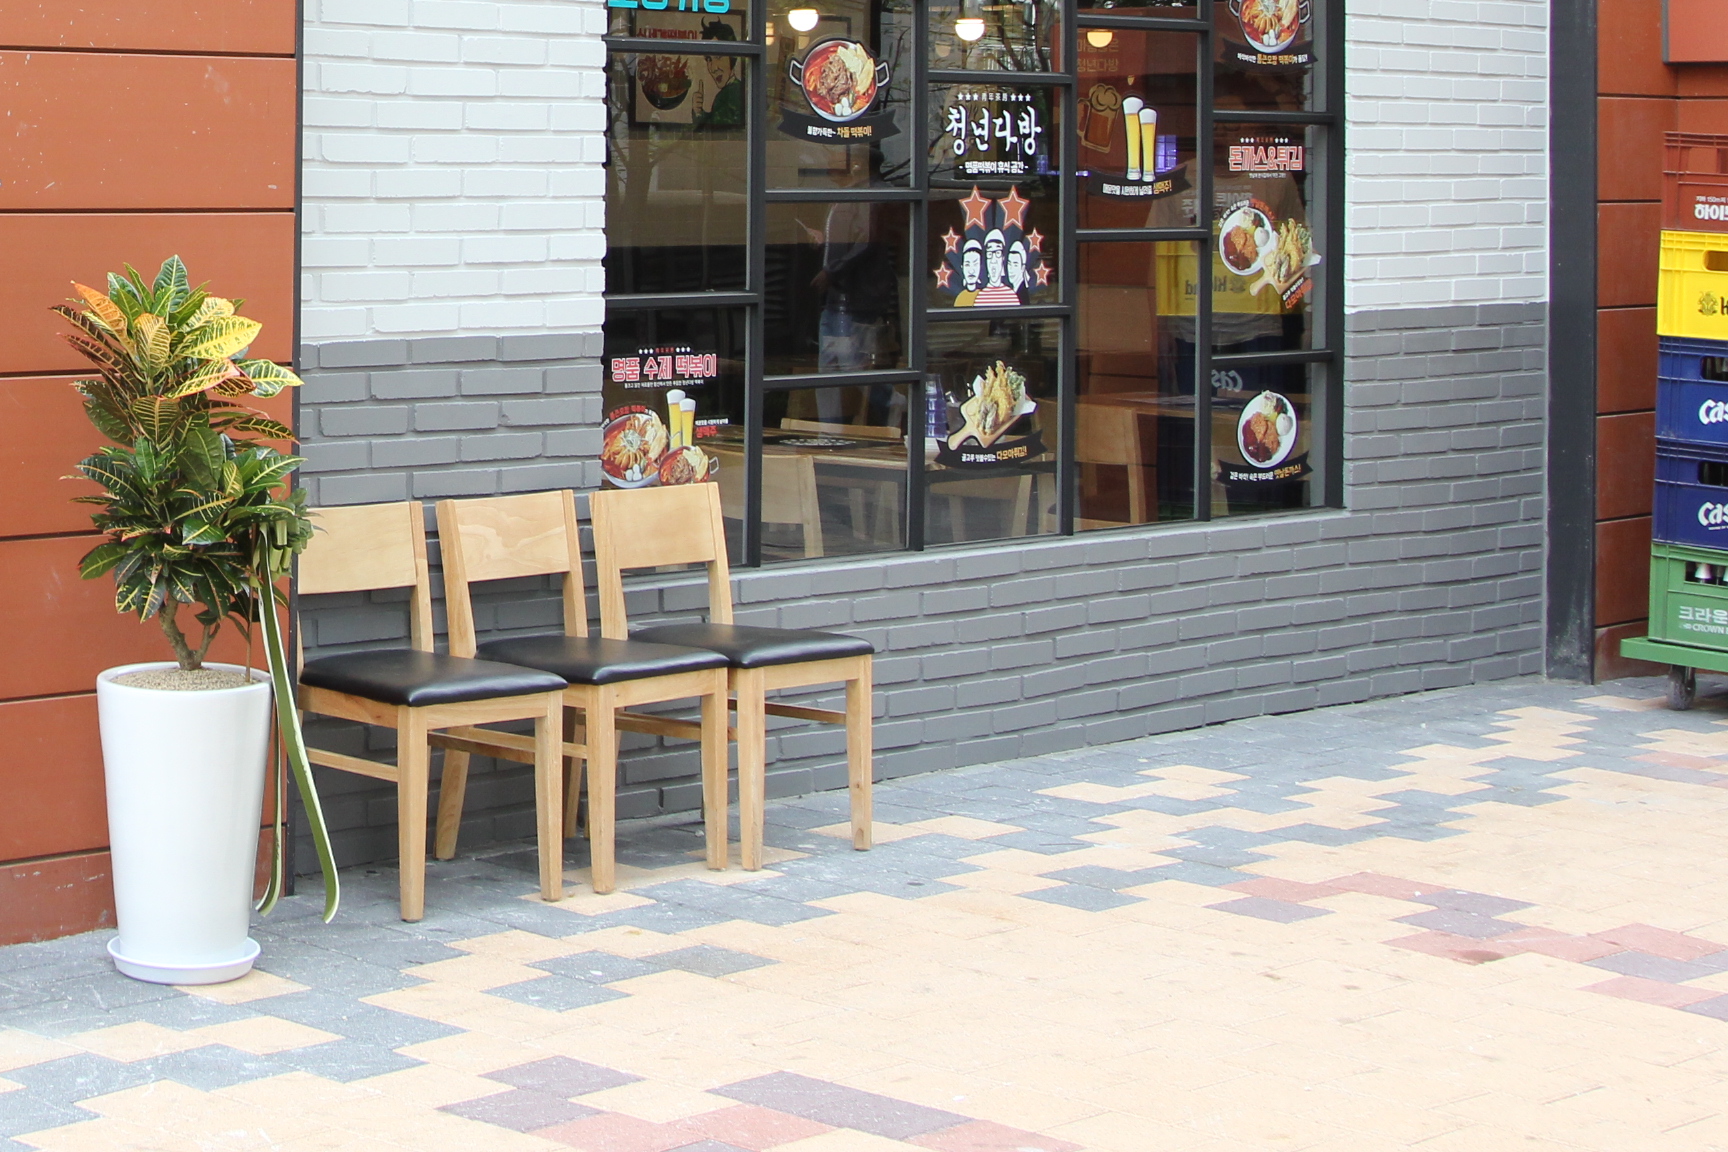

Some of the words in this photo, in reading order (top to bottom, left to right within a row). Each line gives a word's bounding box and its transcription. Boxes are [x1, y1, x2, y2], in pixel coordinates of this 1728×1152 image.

[945, 105, 1042, 156] 청년다방
[1229, 145, 1303, 172] 돈까스&튀김
[611, 357, 640, 382] 명품
[643, 355, 673, 380] 수제
[675, 353, 717, 379] 떡볶이
[1679, 605, 1728, 625] 크라운
[1693, 623, 1724, 635] CROWN
